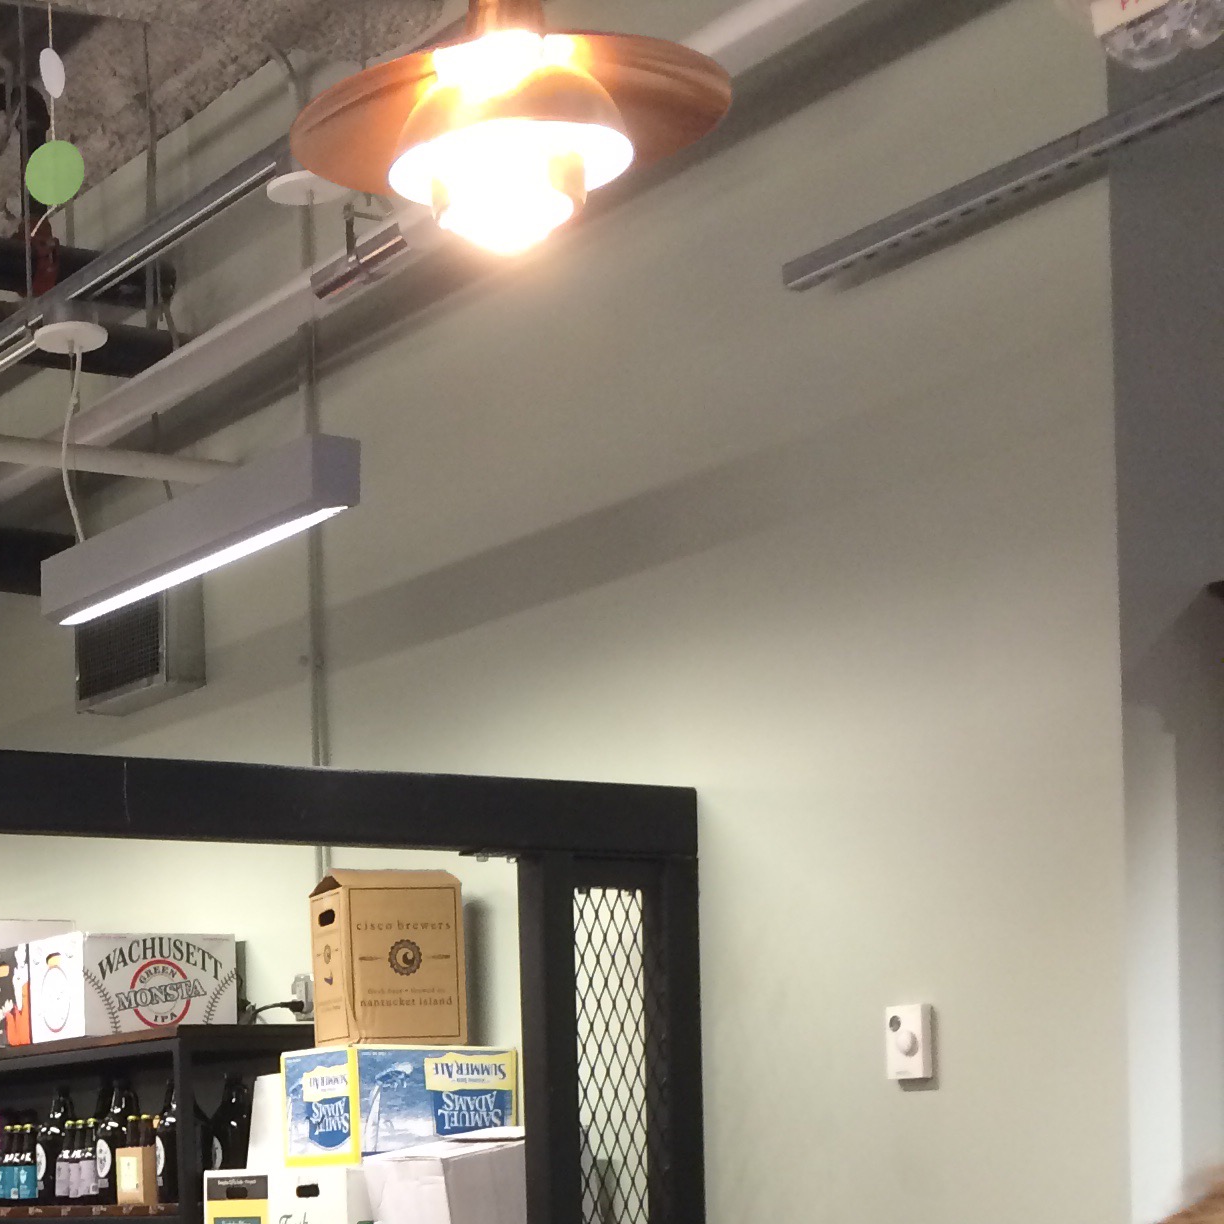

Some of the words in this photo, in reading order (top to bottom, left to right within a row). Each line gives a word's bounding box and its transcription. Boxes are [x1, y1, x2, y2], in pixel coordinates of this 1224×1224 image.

[356, 921, 393, 931] cisco
[397, 919, 451, 931] brewers
[98, 936, 223, 980] WACHUSETT
[138, 965, 177, 984] GREEN
[115, 978, 207, 1011] MONSTA
[360, 997, 416, 1007] nantucket
[419, 996, 452, 1006] island
[153, 1012, 178, 1023] IPA
[454, 1061, 507, 1081] SUMMER
[441, 1091, 498, 1112] ADAMS
[437, 1108, 502, 1128] SAMUEL
